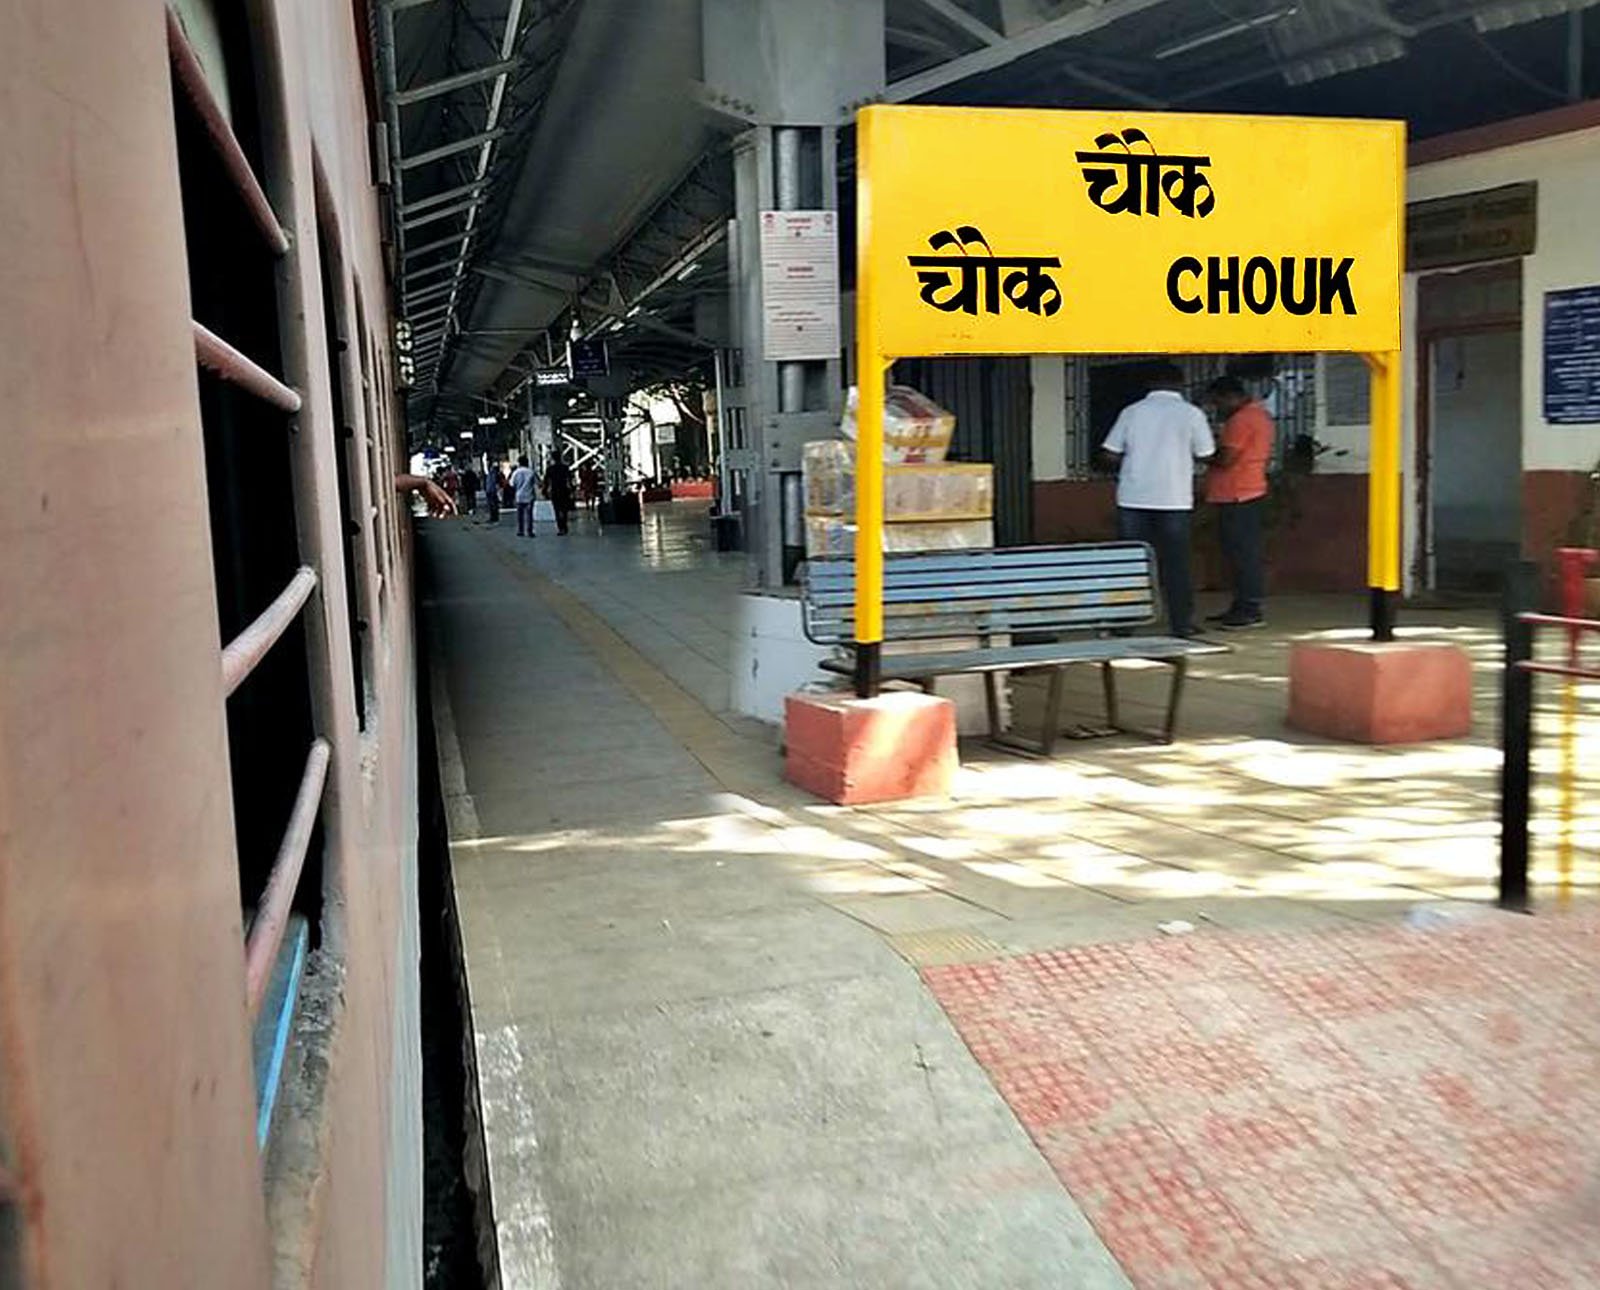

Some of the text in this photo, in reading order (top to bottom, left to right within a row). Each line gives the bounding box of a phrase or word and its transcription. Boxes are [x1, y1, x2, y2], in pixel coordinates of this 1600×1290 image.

[1075, 128, 1216, 218] चौक
[908, 226, 1062, 316] चौक
[1167, 256, 1356, 315] CHOUK
